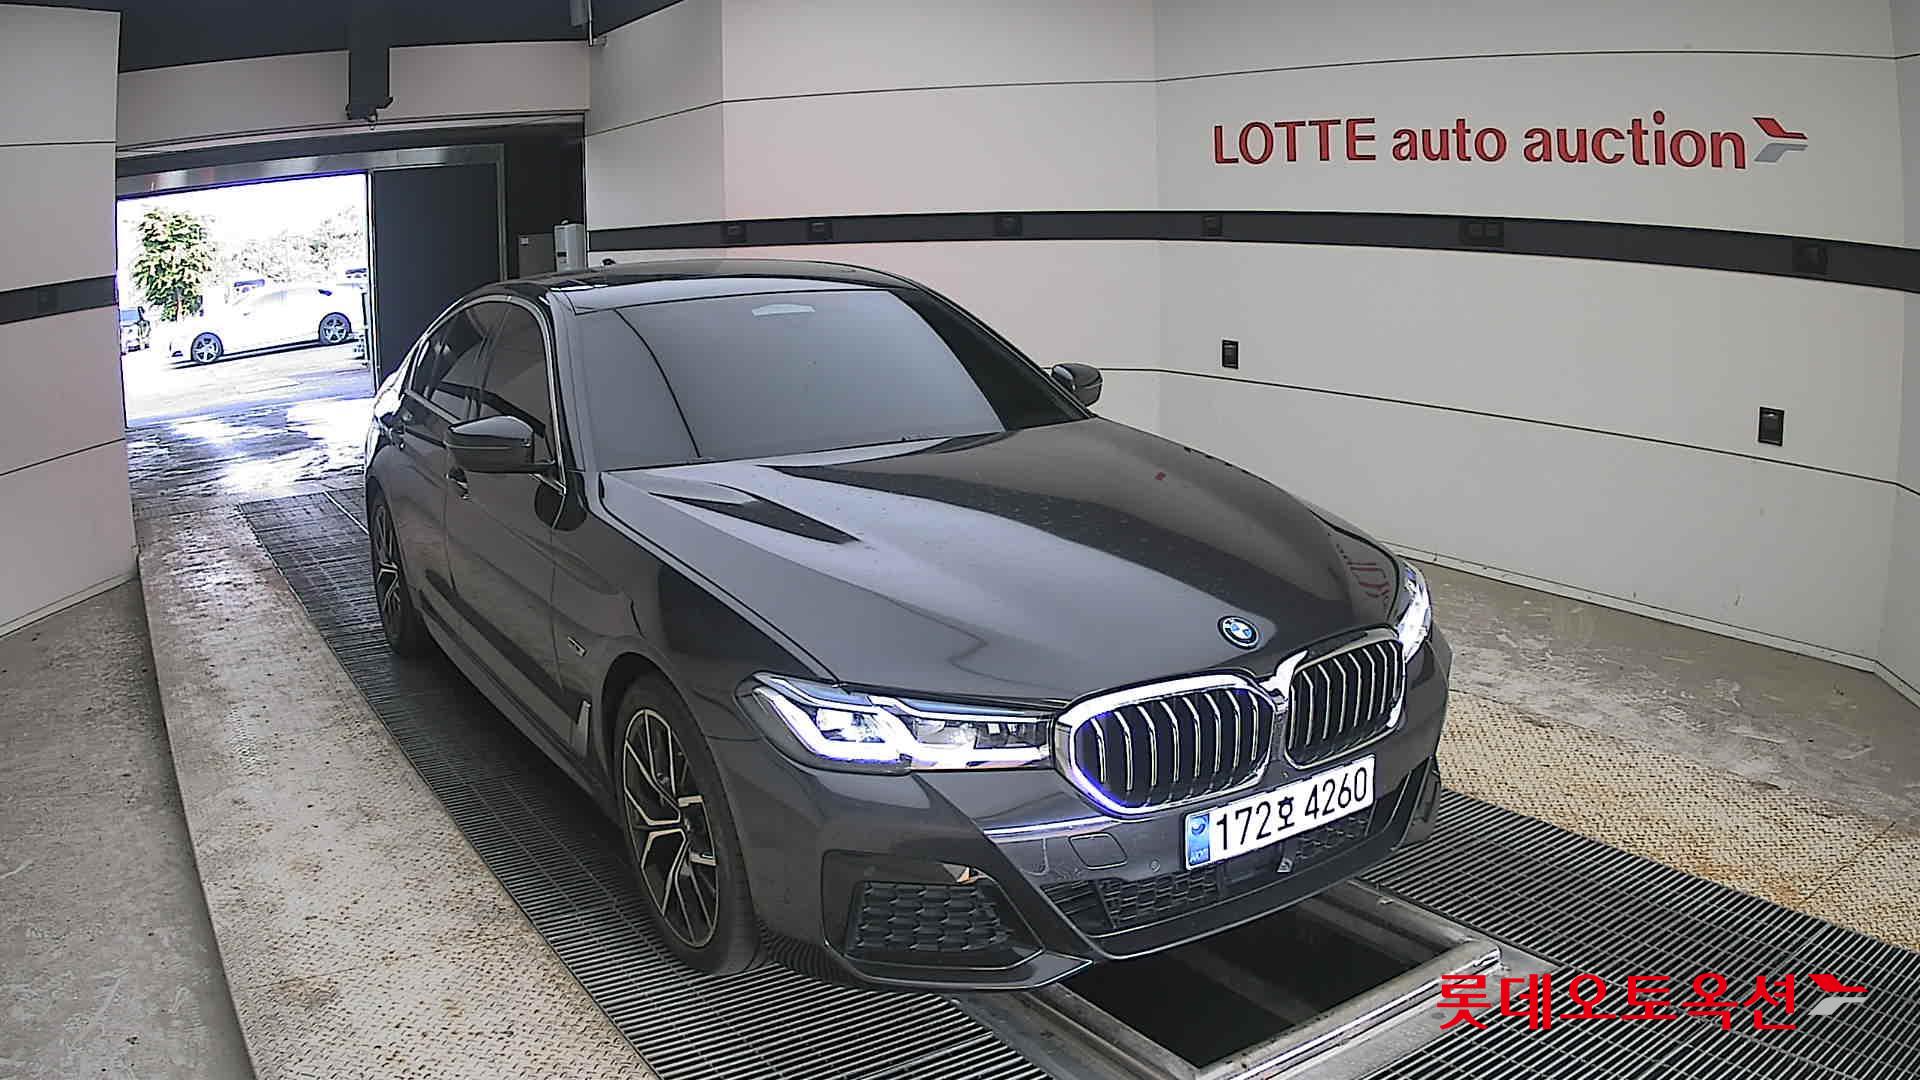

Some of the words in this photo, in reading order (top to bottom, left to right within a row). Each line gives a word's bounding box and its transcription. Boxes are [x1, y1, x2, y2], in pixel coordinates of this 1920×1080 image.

[1213, 118, 1376, 165] LOTTE
[1392, 118, 1507, 163] auto
[1523, 110, 1747, 170] auction
[1216, 797, 1295, 850] 172호
[1305, 768, 1368, 818] 4260
